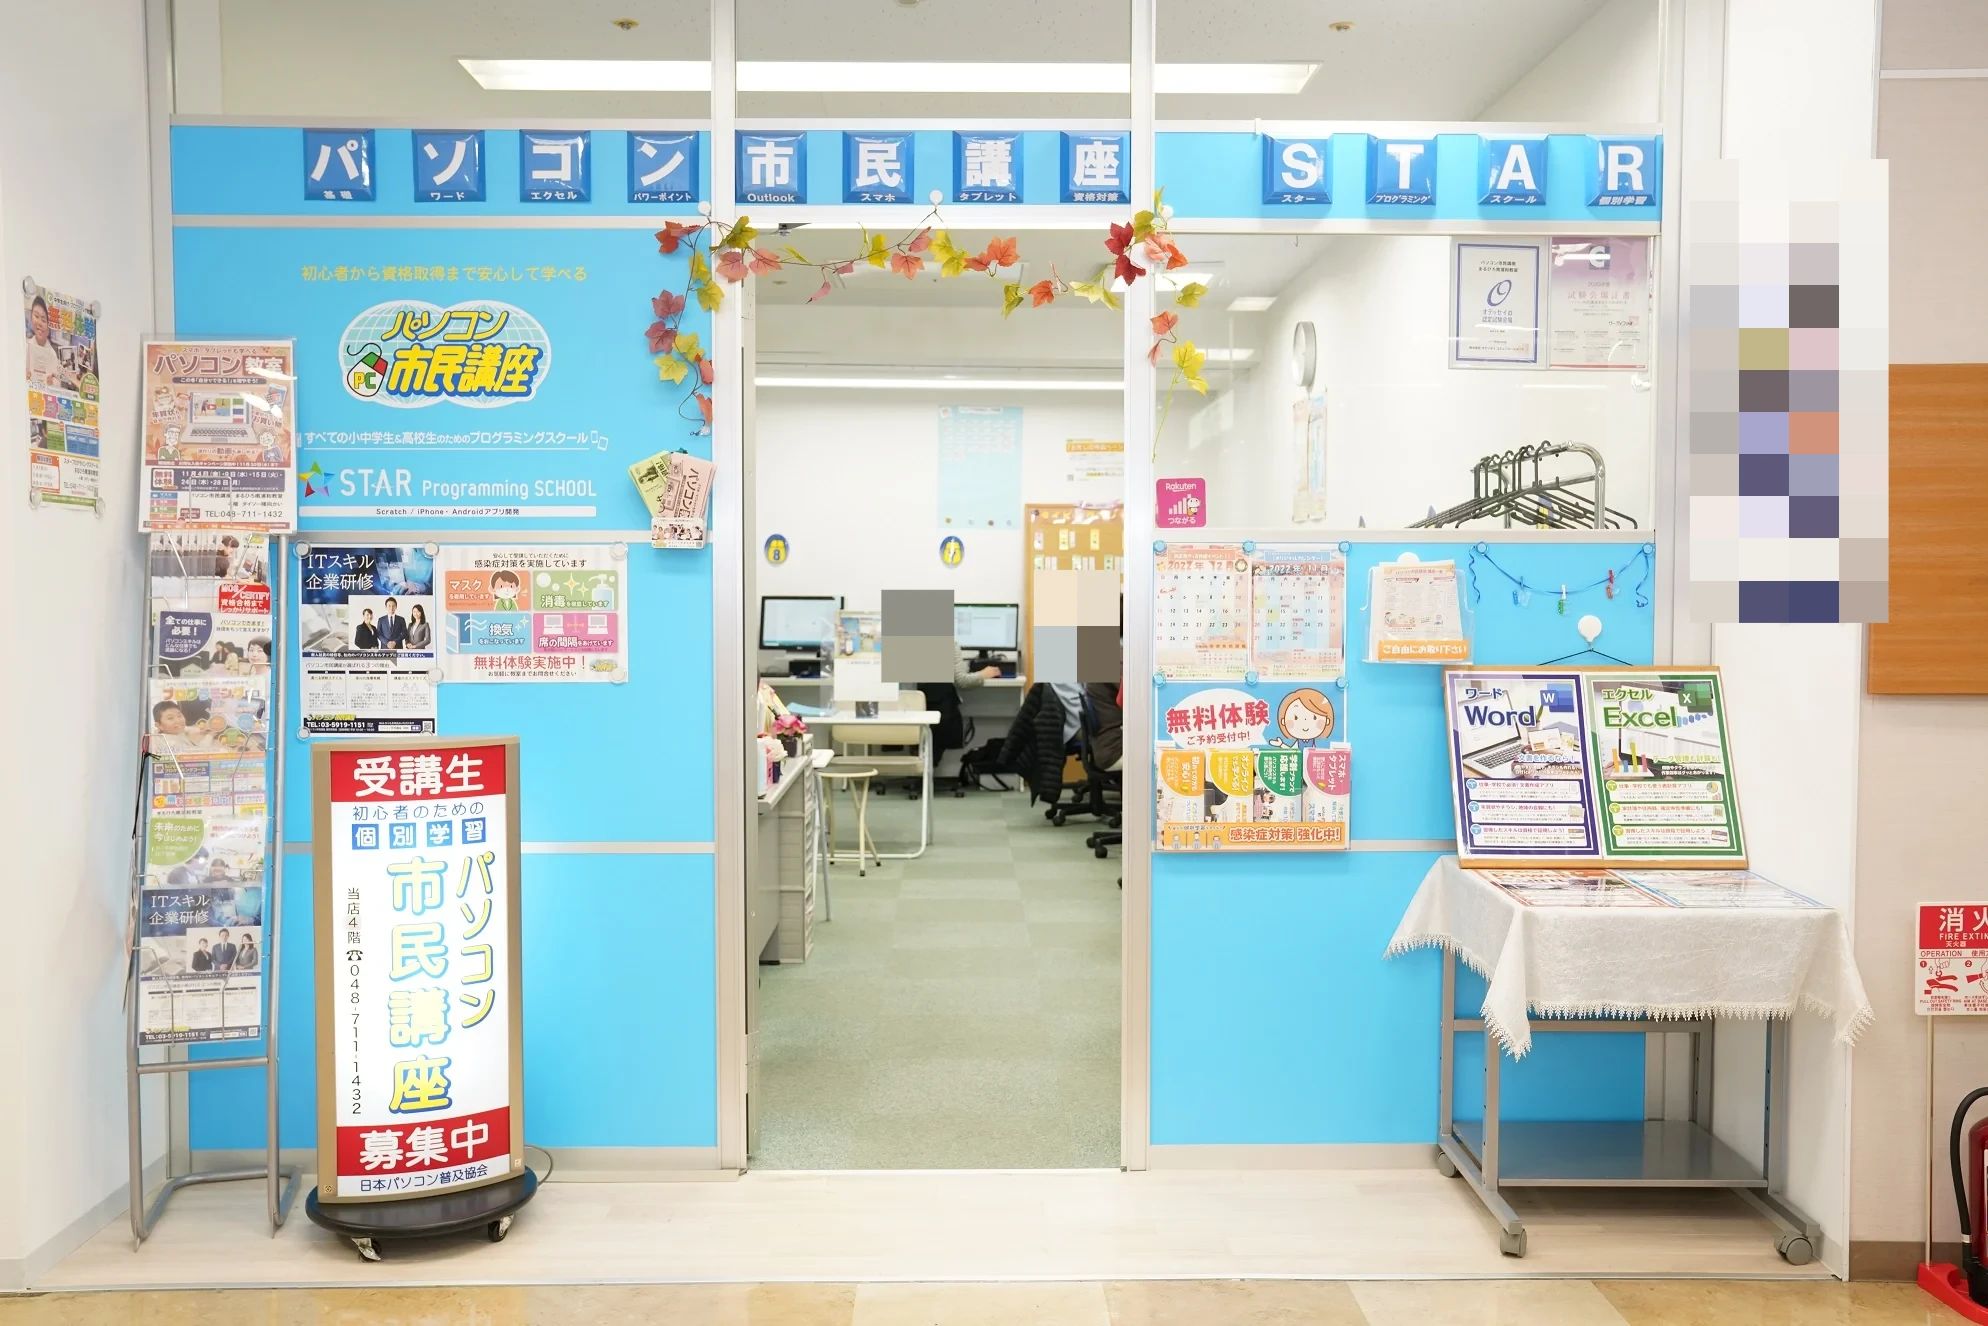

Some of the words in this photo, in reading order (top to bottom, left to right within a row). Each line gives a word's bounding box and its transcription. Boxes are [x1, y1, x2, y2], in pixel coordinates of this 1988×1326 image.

[430, 191, 465, 201] ワード
[531, 191, 578, 200] エクセル
[633, 192, 692, 202] パワーポイント
[747, 193, 795, 203] Outlook
[860, 192, 896, 202] スマホ
[959, 192, 1017, 202] タブレット
[1073, 192, 1119, 203] 資格対策
[1281, 194, 1316, 203] スター
[1375, 194, 1430, 204] プログラミング
[1489, 194, 1537, 204] スクール
[302, 265, 588, 281] 初心者から資格取得まで安心して学べる
[381, 311, 509, 342] パソコン
[387, 344, 542, 396] 市民講座
[353, 371, 376, 389] PC
[340, 468, 412, 497] STAR
[422, 479, 529, 500] Programming
[534, 480, 597, 497] SCHOOL
[1165, 482, 1197, 491] Rakuten
[376, 508, 407, 516] Scratch
[307, 553, 374, 570] ITスキル
[474, 559, 587, 568] 感染症対策を実施しています
[306, 573, 374, 591] 企業研修
[449, 579, 482, 591] マスク
[221, 599, 264, 607] 資格合格まで
[220, 606, 269, 614] しっかりサポート
[165, 615, 207, 626] 全ての仕事に
[171, 627, 198, 636] 必要！
[489, 623, 513, 636] 換気
[538, 636, 614, 648] 席の間隔をあけています
[473, 655, 586, 670] 無料体験実施中！
[1465, 688, 1503, 700] ワード
[1543, 692, 1555, 703] W
[1602, 688, 1653, 701] エクセル
[1682, 693, 1692, 704] X
[1166, 699, 1270, 735] 無料体験
[1465, 705, 1536, 727] Word
[1603, 706, 1678, 728] Excel
[1187, 731, 1251, 746] ご予約受付中!
[353, 753, 485, 797] 受講生
[352, 801, 485, 821] 初心者のための
[355, 819, 484, 848] 個別学習
[1229, 827, 1294, 842] 感染症対策
[1297, 826, 1341, 841] 強化中!
[151, 894, 210, 908] ITスキル
[149, 910, 209, 926] 企業研修
[347, 887, 361, 945] 当店4階
[456, 851, 495, 1029] パソコン
[1939, 932, 1960, 941] FIRE
[1920, 950, 1963, 958] OPERATION
[387, 856, 453, 1115] 市民講座
[359, 1119, 489, 1171] 募集中
[360, 1163, 488, 1192] 日本パソコン普及協会
